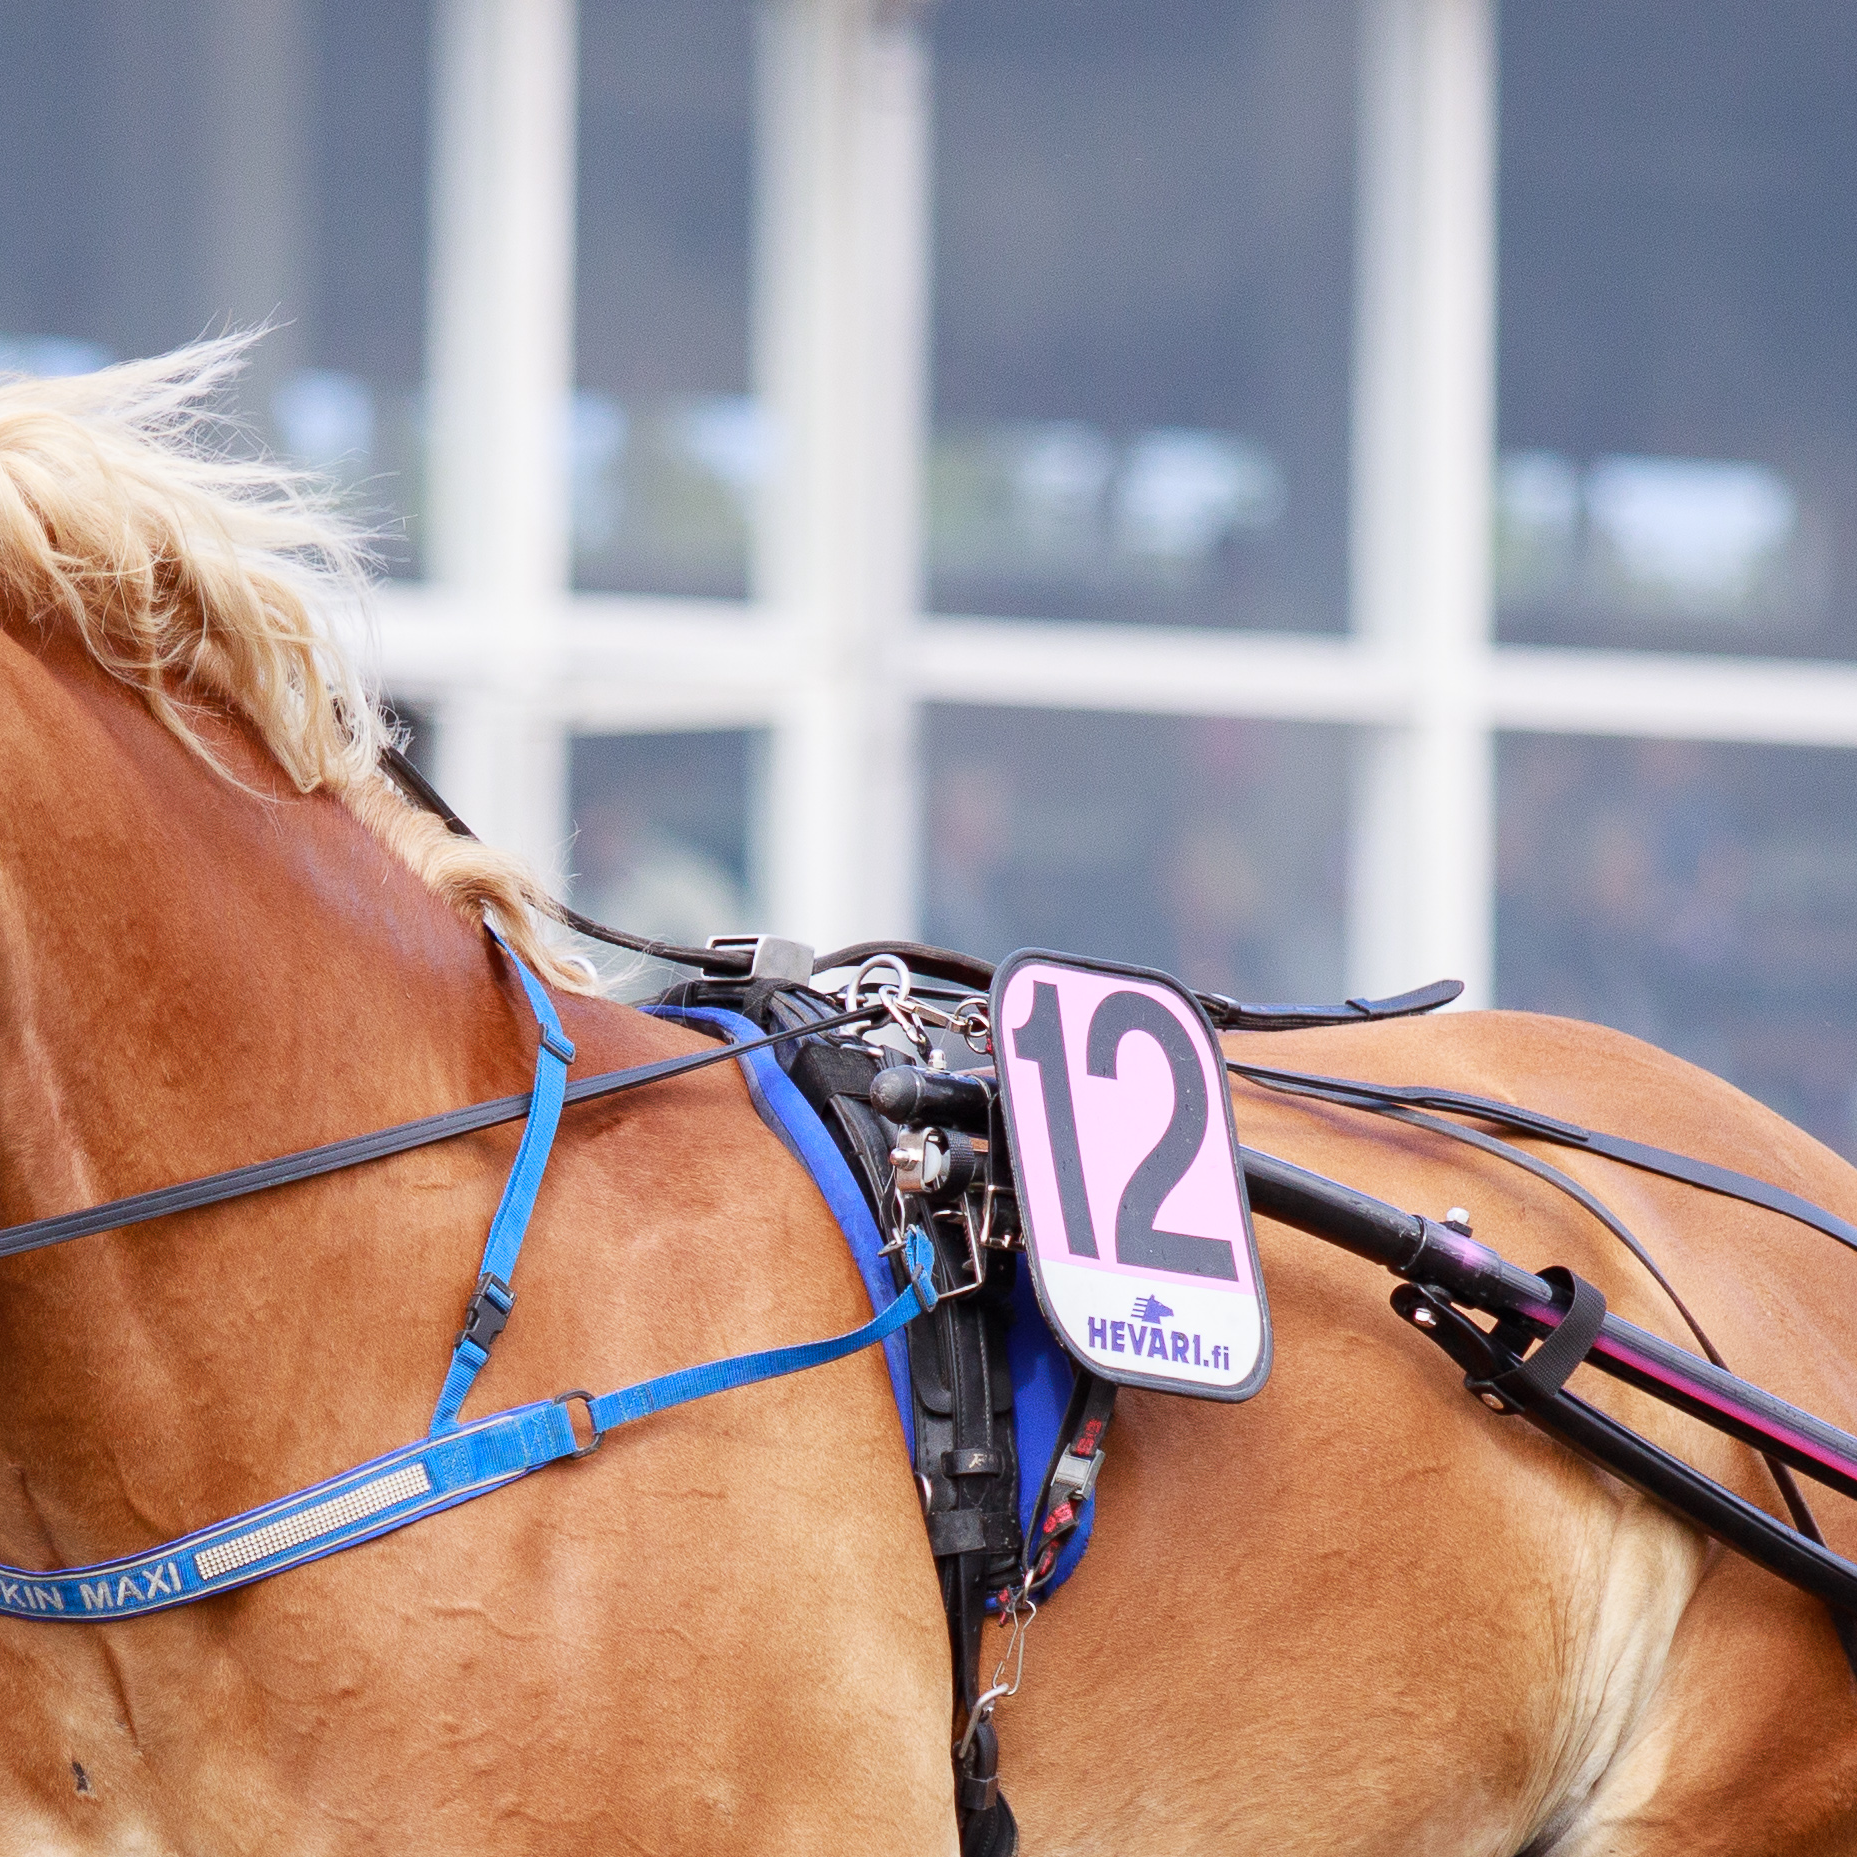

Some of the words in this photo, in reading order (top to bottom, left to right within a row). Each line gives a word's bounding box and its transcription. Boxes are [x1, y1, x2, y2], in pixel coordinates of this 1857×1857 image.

[1011, 979, 1240, 1283] 12
[1087, 1315, 1230, 1371] HEVARI.fi
[78, 1561, 183, 1611] MAXI
